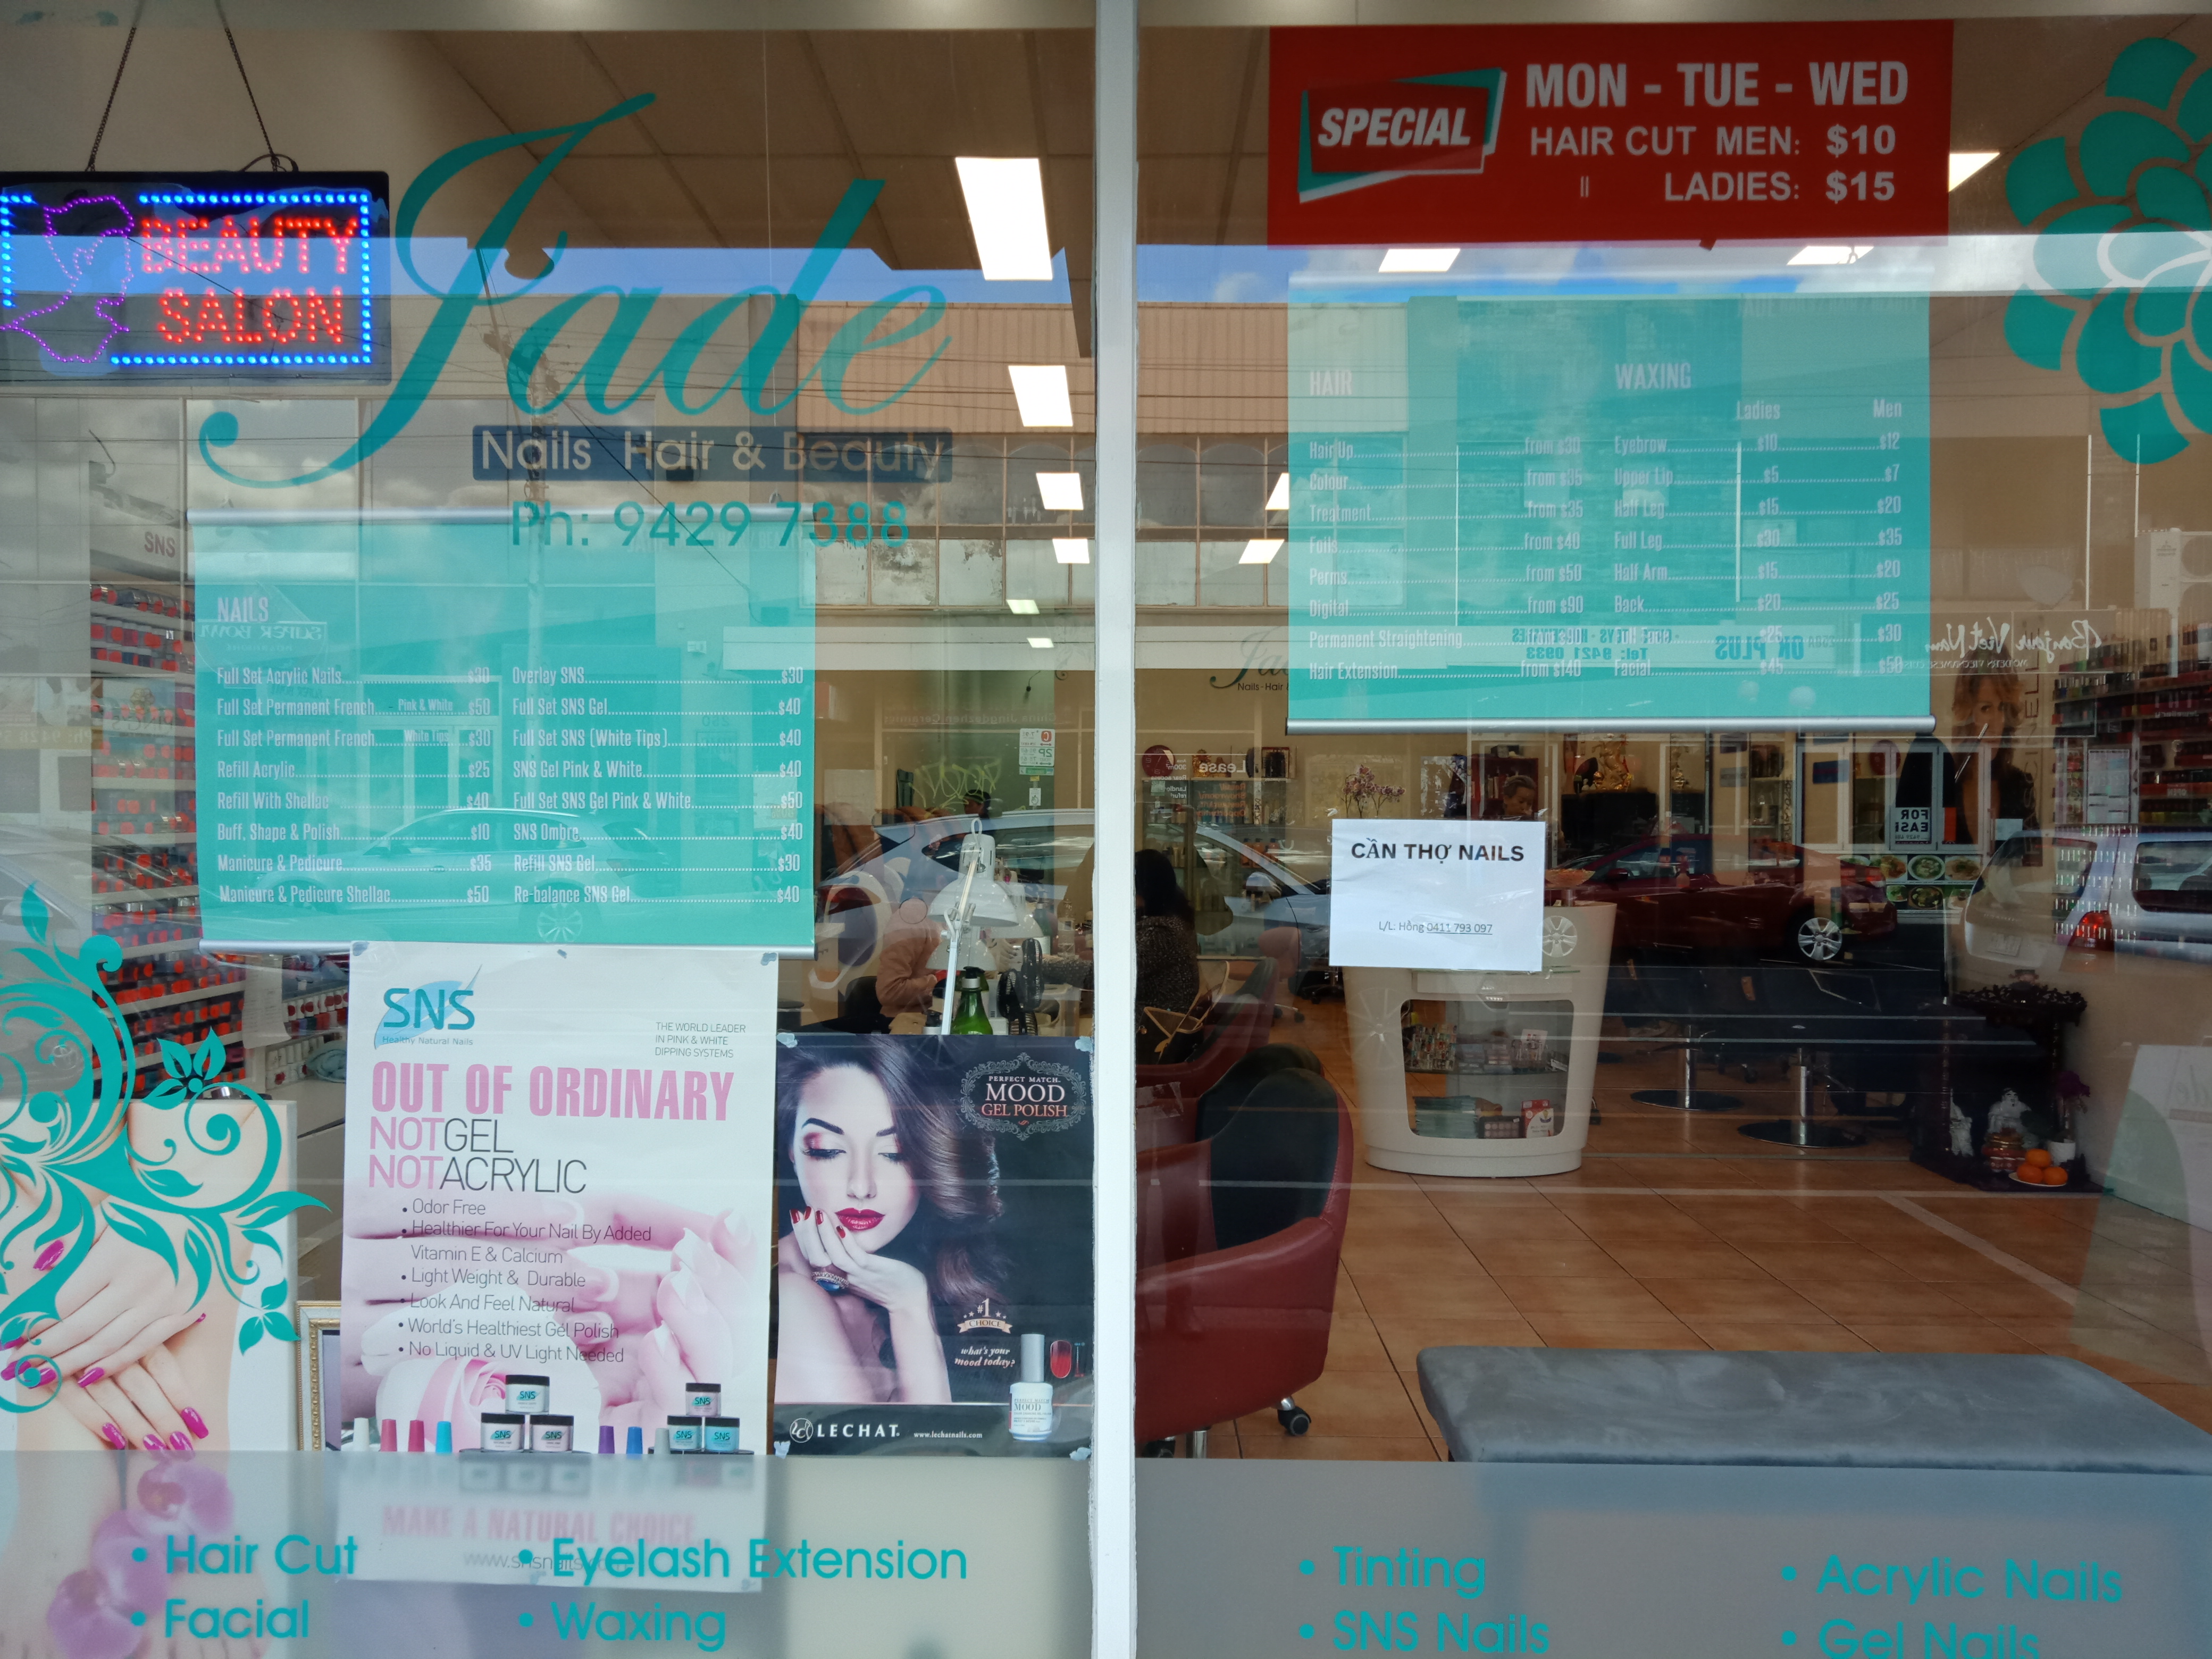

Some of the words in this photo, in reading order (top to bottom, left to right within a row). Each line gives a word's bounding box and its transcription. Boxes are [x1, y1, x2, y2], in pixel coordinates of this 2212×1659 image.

[1526, 63, 1627, 108] MON
[1677, 62, 1759, 106] TUE
[1808, 61, 1908, 106] WED
[1318, 107, 1471, 147] SPECIAL
[1530, 127, 1613, 156] HAIR
[1626, 126, 1696, 156] CUT
[1716, 125, 1801, 156] MEN:
[1826, 123, 1896, 158] $10
[1664, 172, 1801, 202] LADIES:
[1826, 170, 1896, 203] $15
[140, 216, 359, 274] BEAUTY
[198, 92, 953, 489] Jade
[157, 287, 346, 345] SALON
[1615, 363, 1692, 390] WAXING
[1736, 400, 1781, 421] Ladies
[1873, 399, 1903, 418] Men
[482, 431, 592, 471] Nails
[624, 430, 710, 471] Hair
[732, 431, 766, 471] &
[783, 433, 946, 480] Beauty
[512, 500, 589, 547] Ph:
[613, 500, 752, 547] 9429
[776, 500, 910, 548] 7388
[144, 532, 175, 558] SNS
[1309, 537, 1338, 554] Foils
[1524, 532, 1553, 551] from
[1557, 532, 1581, 551] $40
[1614, 564, 1638, 581] Half
[1643, 565, 1668, 582] Arm
[1757, 562, 1779, 580] $15
[1876, 560, 1901, 579] $20
[217, 597, 270, 623] NAILS
[513, 667, 557, 686] Overlay
[560, 667, 585, 684] SNS
[781, 666, 803, 685] $30
[1265, 683, 1284, 691] Hair
[513, 729, 534, 747] Full
[538, 729, 558, 747] Set
[562, 729, 585, 747] SNS
[590, 728, 632, 748] (White
[635, 728, 668, 749] Tips)
[779, 729, 802, 747] $40
[217, 761, 249, 778] Refill
[253, 761, 296, 781] Acrylic
[468, 760, 491, 778] $25
[217, 824, 247, 842] Buff,
[250, 824, 286, 843] Shape
[289, 824, 300, 841] &
[303, 823, 340, 841] Polish
[470, 823, 490, 842] $10
[1351, 837, 1396, 859] CẦN
[1404, 843, 1452, 865] THỢ
[1459, 844, 1524, 862] NAILS
[220, 885, 275, 903] Manicure
[278, 886, 288, 903] &
[290, 885, 343, 903] Pedicure
[347, 885, 391, 903] Shellac
[467, 886, 489, 904] $50
[1378, 921, 1396, 932] L/L:
[1398, 920, 1425, 933] Hồng
[1427, 922, 1451, 933] 0411
[1454, 923, 1471, 933] 793
[1474, 923, 1493, 933] 097
[383, 987, 475, 1030] SNS
[656, 1022, 674, 1031] THE
[675, 1023, 708, 1032] WORLD
[710, 1024, 746, 1033] LEADER
[382, 1035, 415, 1045] Healthy
[418, 1036, 450, 1046] Natural
[452, 1037, 473, 1046] Nails
[655, 1035, 665, 1043] IN
[667, 1035, 689, 1044] PINK
[691, 1035, 698, 1044] &
[700, 1036, 728, 1045] WHITE
[655, 1047, 691, 1057] DIPPING
[693, 1048, 734, 1058] SYSTEMS
[372, 1061, 449, 1112] OUT
[465, 1063, 513, 1115] OF
[530, 1065, 734, 1121] ORDINARY
[985, 1083, 1066, 1102] MOOD
[981, 1103, 1011, 1117] GEL
[1013, 1104, 1068, 1117] POLISH
[412, 1198, 449, 1214] Odor
[453, 1200, 486, 1215] Free
[412, 1220, 481, 1236] Healthier
[484, 1222, 509, 1237] For
[512, 1222, 542, 1239] Your
[549, 1222, 577, 1239] Nail
[582, 1224, 601, 1243] By
[604, 1225, 652, 1242] Added
[411, 1244, 467, 1261] Vitamin
[471, 1246, 482, 1262] E
[485, 1247, 497, 1262] &
[501, 1247, 563, 1264] Calcium
[412, 1267, 448, 1286] Light
[451, 1269, 503, 1288] Weight
[506, 1270, 519, 1285] &
[527, 1270, 586, 1287] Durable
[410, 1293, 446, 1309] Look
[449, 1294, 480, 1310] And
[484, 1294, 515, 1311] Feel
[519, 1295, 575, 1312] Natural
[977, 1298, 992, 1318] #1
[408, 1318, 463, 1334] World's
[467, 1319, 542, 1337] Healthiest
[545, 1321, 571, 1338] Gel
[573, 1322, 619, 1339] Polish
[969, 1319, 1002, 1328] CHOICE
[409, 1341, 431, 1356] No
[435, 1342, 480, 1361] Liquid
[483, 1344, 496, 1359] &
[500, 1344, 522, 1359] UV
[525, 1344, 563, 1364] Light
[566, 1345, 624, 1363] Needed
[954, 1356, 983, 1367] mood
[984, 1356, 1016, 1369] today?
[961, 1346, 988, 1355] what's
[989, 1348, 1011, 1359] your
[519, 1389, 537, 1401] SNS
[1013, 1403, 1042, 1412] MOOD
[494, 1429, 511, 1440] SNS
[545, 1430, 563, 1441] SNS
[817, 1423, 899, 1437] LECHAT
[914, 1430, 983, 1439] www.lechatnails.com
[166, 1535, 259, 1574] Hair
[275, 1534, 358, 1575] Cut
[553, 1538, 730, 1586] Eyelash
[749, 1539, 967, 1580] Extension
[1333, 1546, 1485, 1599] Tinting
[1816, 1554, 1985, 1605] Acrylic
[2005, 1559, 2123, 1603] Nails
[165, 1599, 309, 1639] Facial
[550, 1601, 726, 1653] Waxing
[1333, 1610, 1419, 1652] SNS
[1437, 1612, 1550, 1654] Nails
[1819, 1618, 1904, 1659] Gel
[1924, 1621, 2040, 1659] Nails
